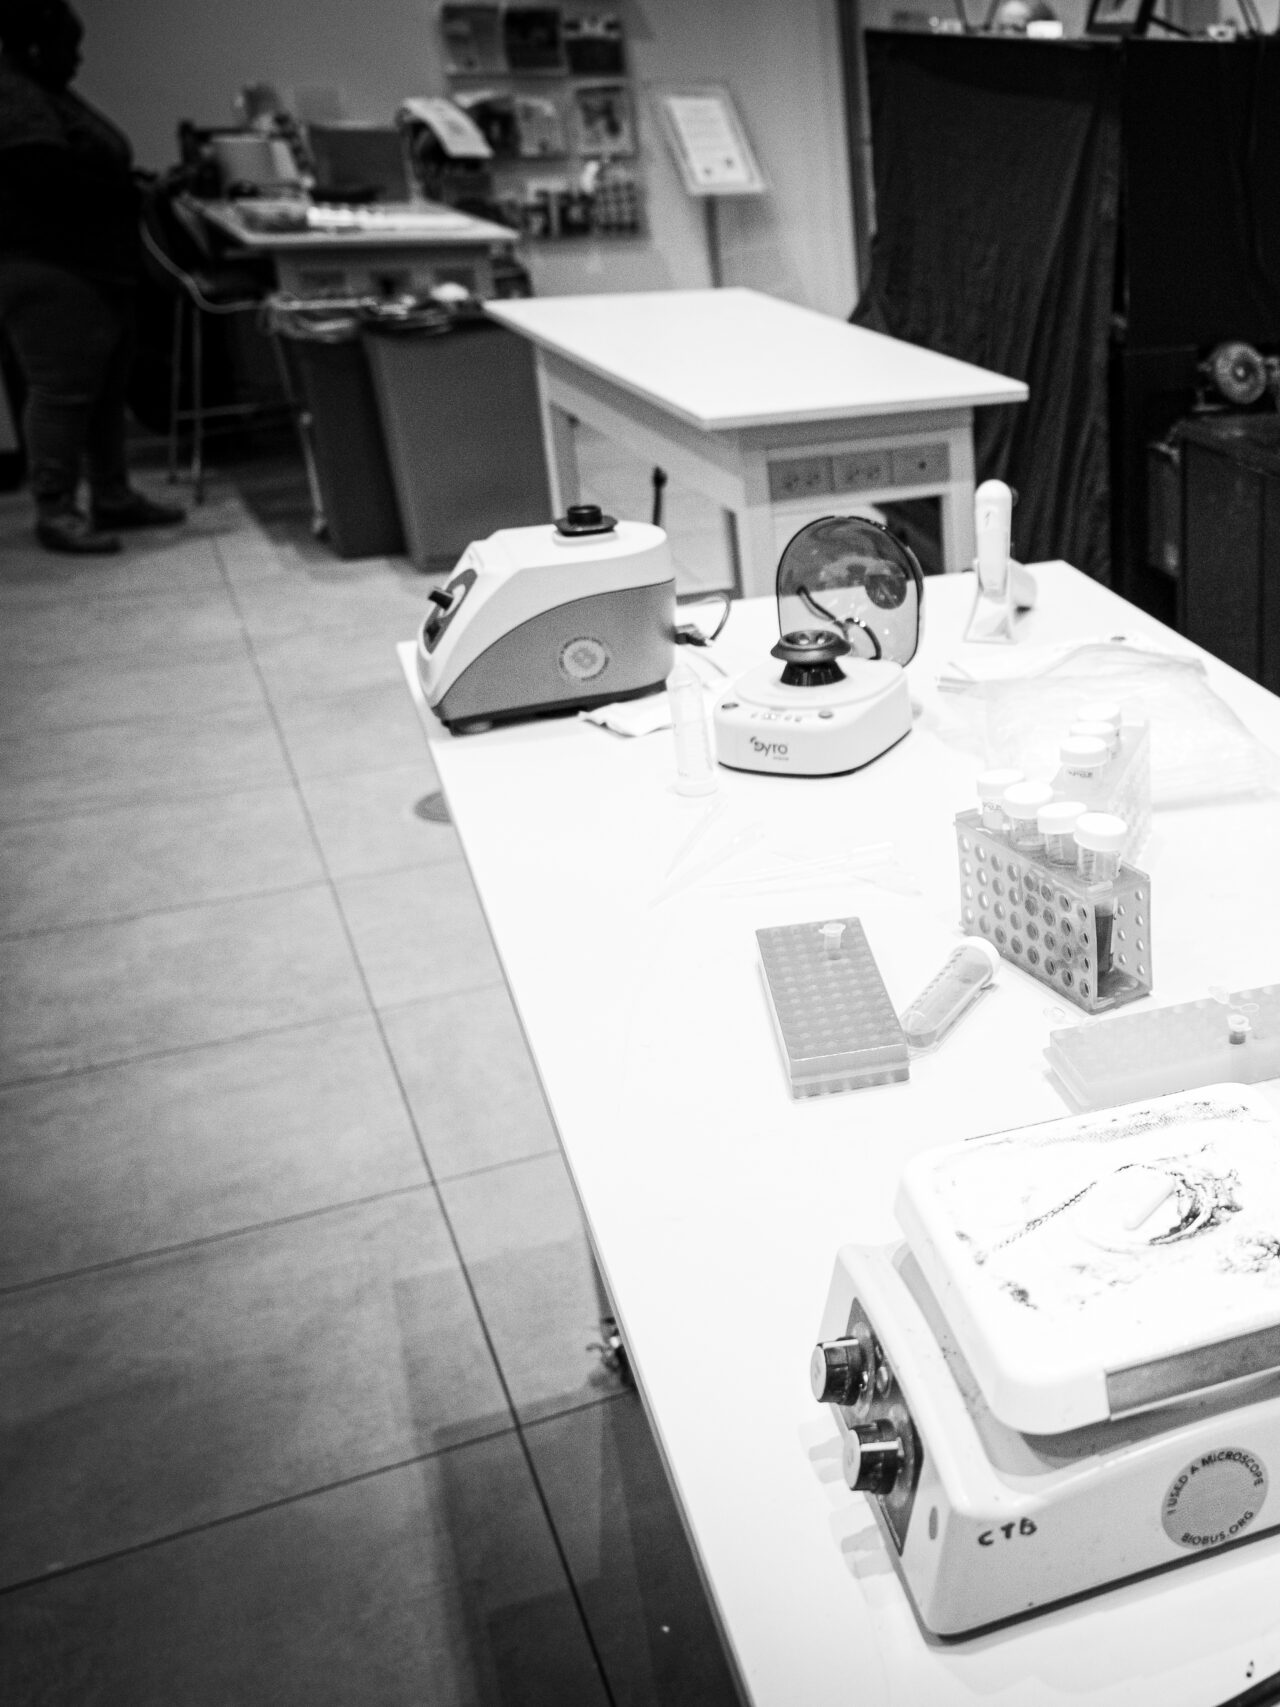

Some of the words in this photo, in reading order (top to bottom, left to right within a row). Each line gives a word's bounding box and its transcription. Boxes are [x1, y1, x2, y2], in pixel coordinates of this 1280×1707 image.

[1167, 1475, 1189, 1507] USED
[1190, 1465, 1199, 1475] A
[1201, 1451, 1264, 1486] MICROSCOPE
[1181, 1510, 1254, 1545] BIOBUS.ORG
